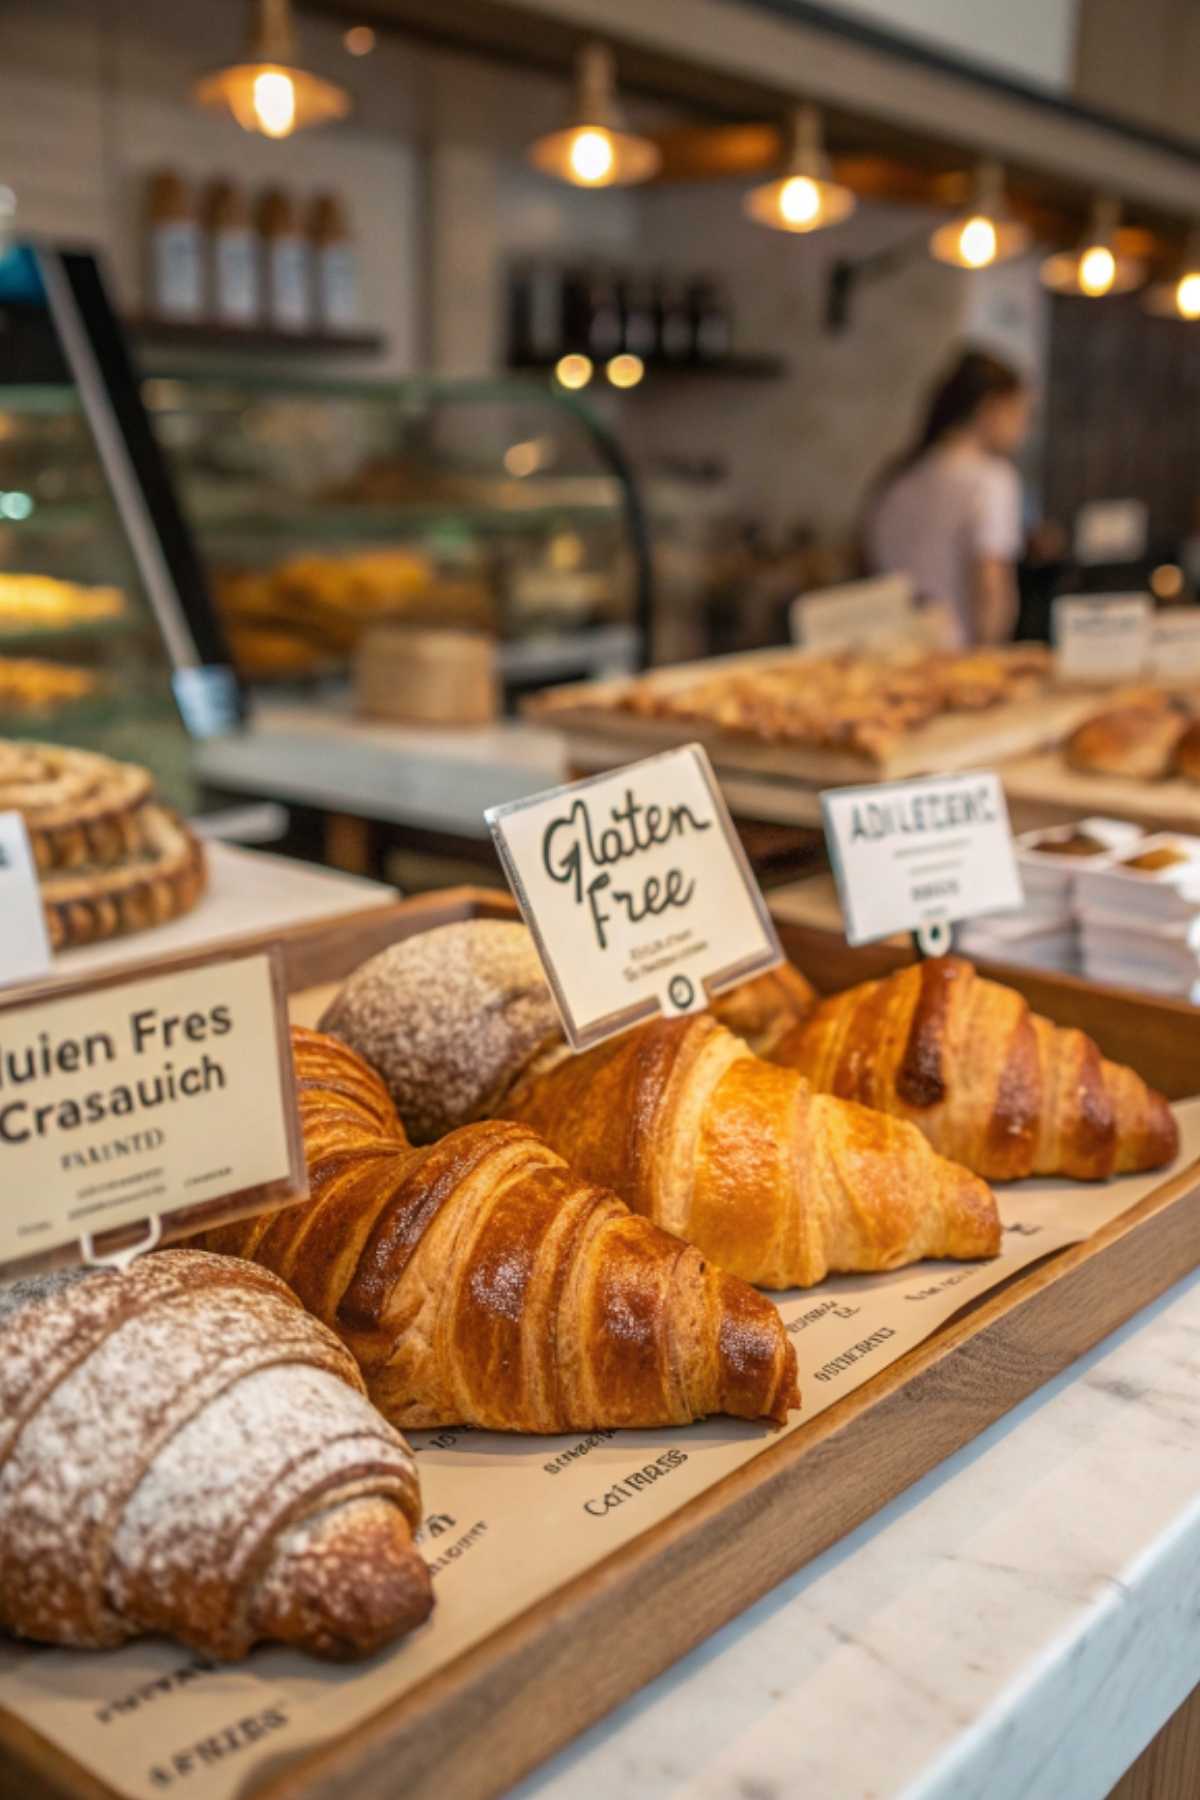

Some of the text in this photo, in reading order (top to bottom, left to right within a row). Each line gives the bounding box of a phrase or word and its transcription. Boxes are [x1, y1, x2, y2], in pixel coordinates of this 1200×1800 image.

[586, 868, 696, 949] Free
[0, 1005, 232, 1089] uien Fres
